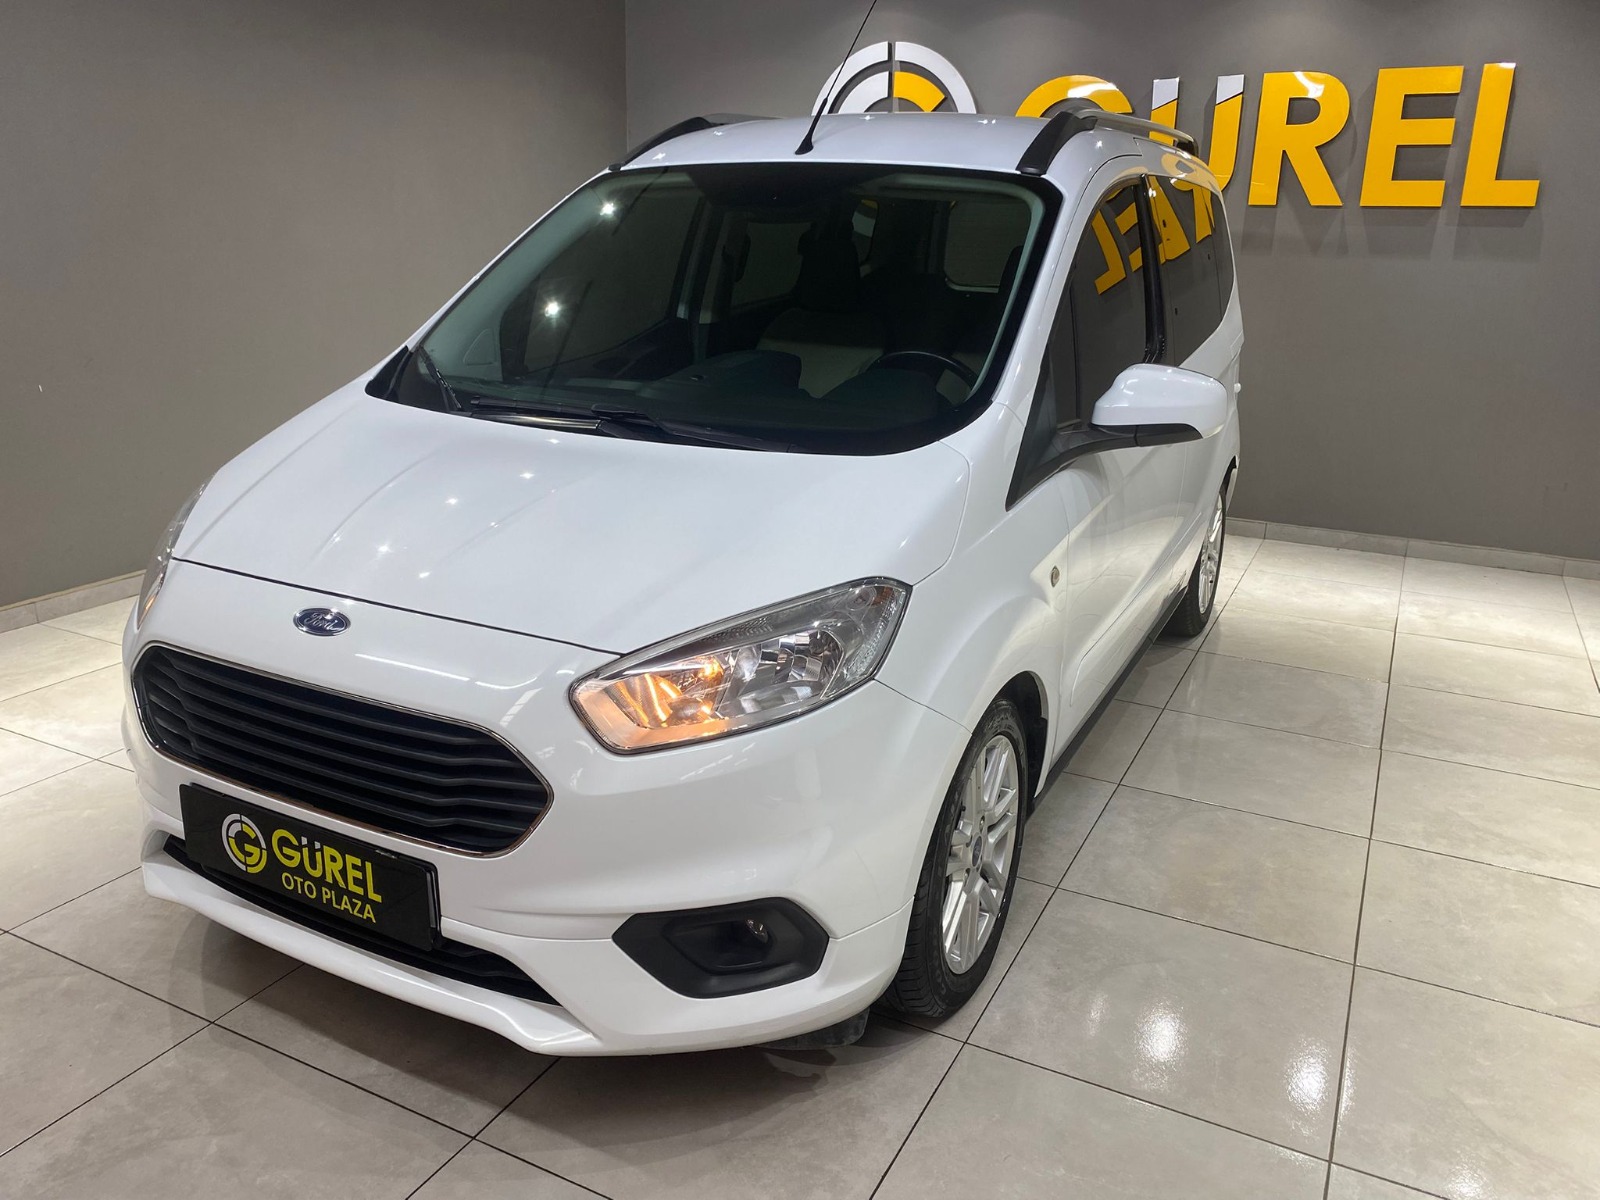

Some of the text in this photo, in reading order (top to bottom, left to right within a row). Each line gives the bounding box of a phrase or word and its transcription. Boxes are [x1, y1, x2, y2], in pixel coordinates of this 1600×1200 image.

[303, 612, 346, 631] Ford
[271, 828, 382, 903] GÜREL
[281, 872, 376, 923] OTO PLAZA
